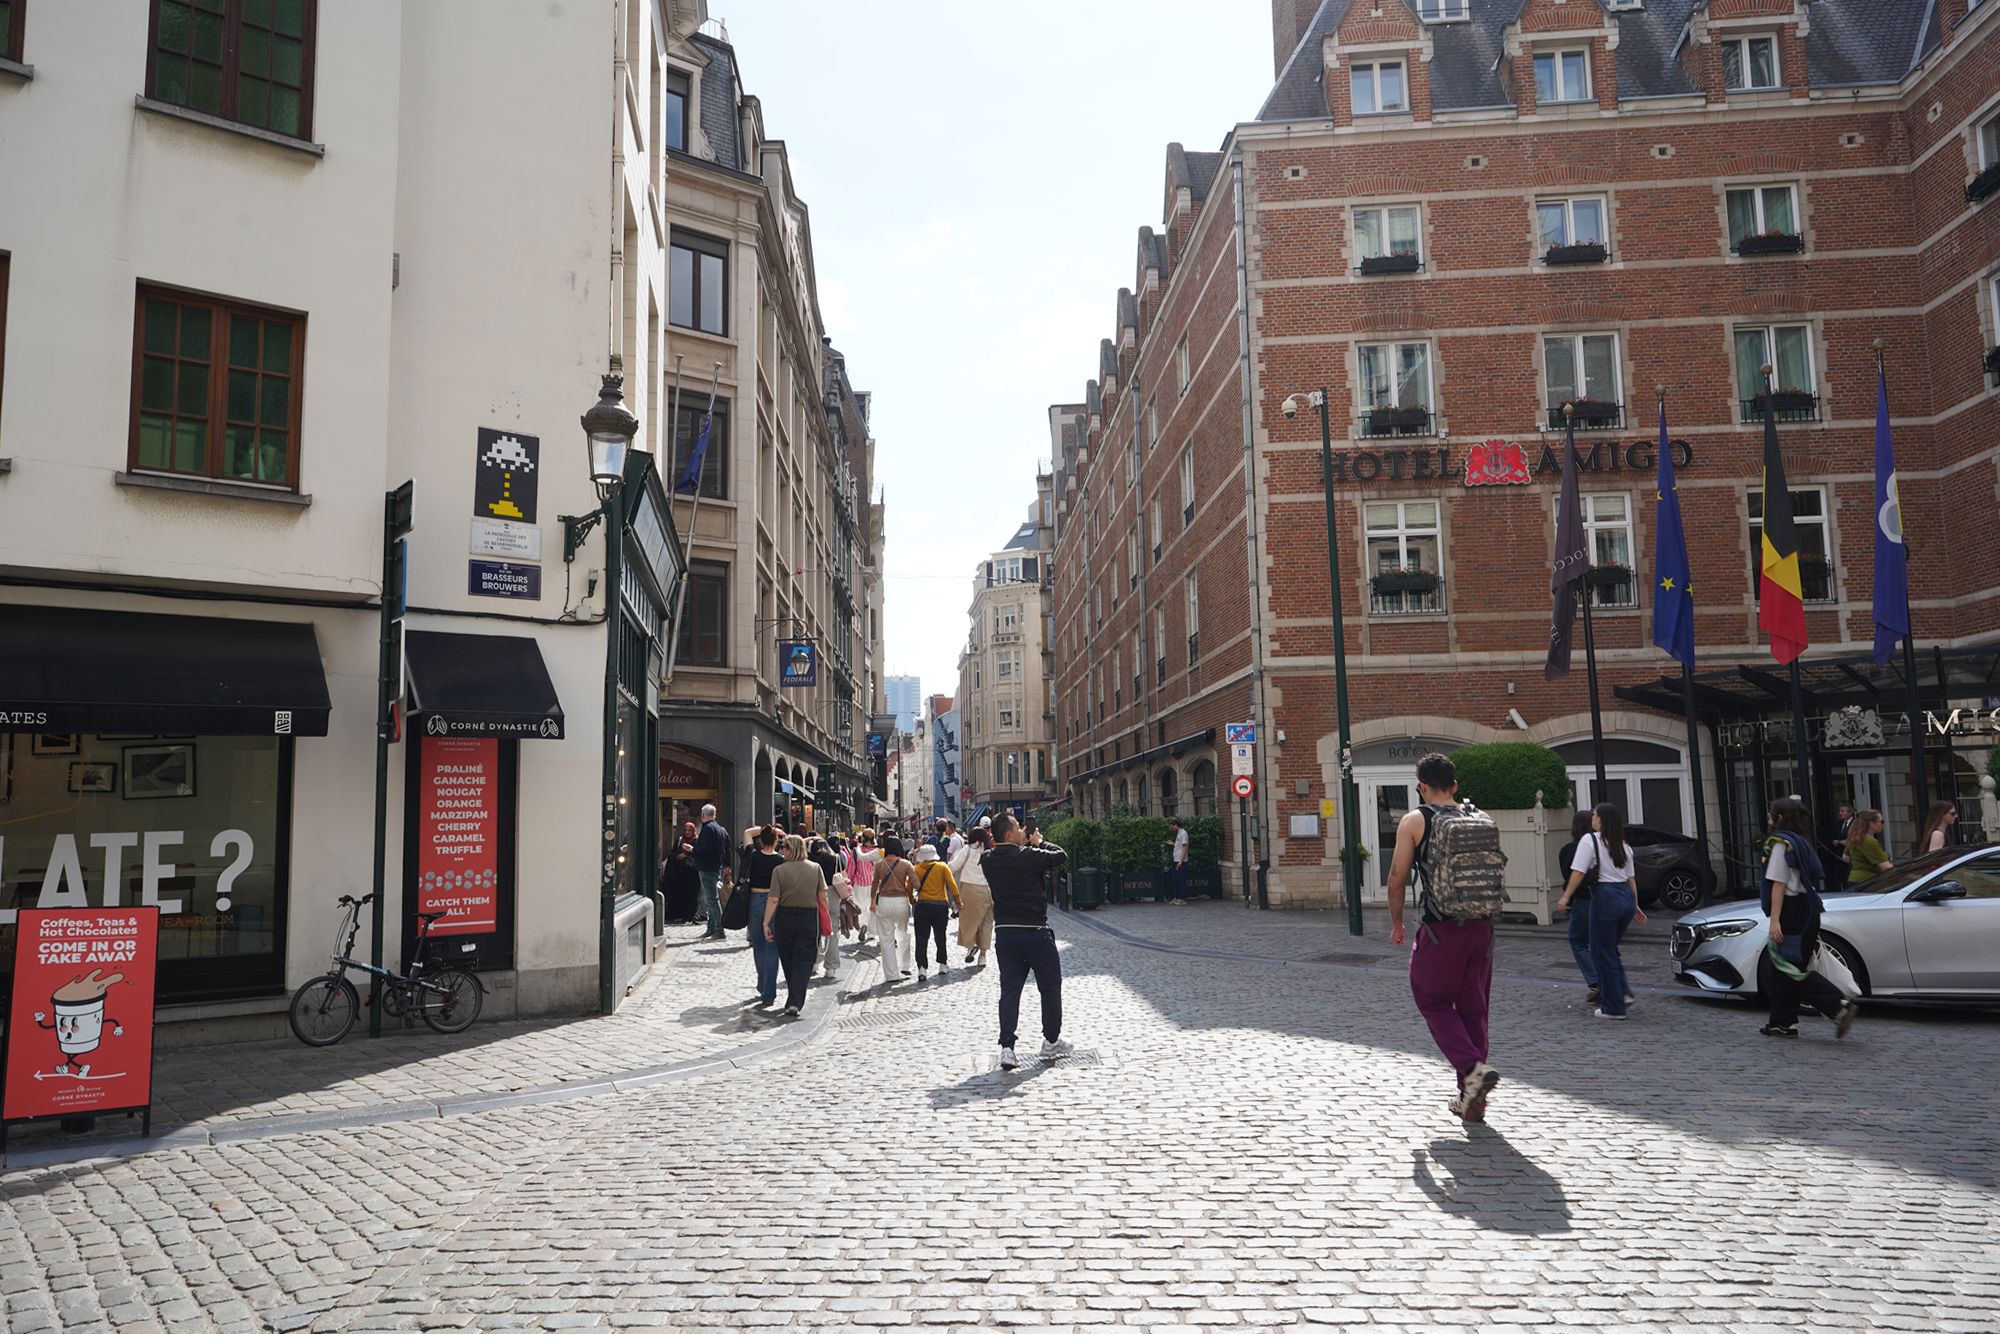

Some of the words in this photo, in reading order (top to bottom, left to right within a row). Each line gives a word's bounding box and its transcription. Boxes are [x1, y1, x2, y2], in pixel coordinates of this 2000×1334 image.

[1319, 448, 1460, 482] HOTEL
[1535, 439, 1693, 474] AMIGO
[482, 572, 528, 584] BRASSEURS
[482, 581, 528, 593] BROUWERS
[451, 722, 485, 730] CORNÉ
[489, 723, 538, 731] DYNASTIE
[437, 763, 483, 774] PRALINÉ
[433, 776, 486, 785] GANACHE
[659, 769, 693, 784] alace
[437, 788, 483, 797] NOUGAT
[437, 799, 483, 808] ORANGE
[430, 810, 488, 820] MARZIPAN
[437, 822, 481, 831] CHERRY
[433, 834, 485, 843] CARAMEL
[435, 845, 482, 855] TRUFFLE
[210, 829, 254, 912] ?
[426, 898, 460, 908] CATCH
[462, 897, 490, 905] THEM
[446, 908, 465, 916] ALL
[467, 907, 471, 915] !
[41, 918, 94, 928] Coffees,
[97, 918, 125, 927] Teas
[128, 917, 137, 926] &
[40, 928, 63, 937] Hot
[67, 927, 138, 936] Chocolates
[39, 942, 87, 953] COME
[92, 941, 108, 951] IN
[113, 940, 136, 951] OR
[38, 953, 81, 964] TAKE
[85, 951, 136, 963] AWAY
